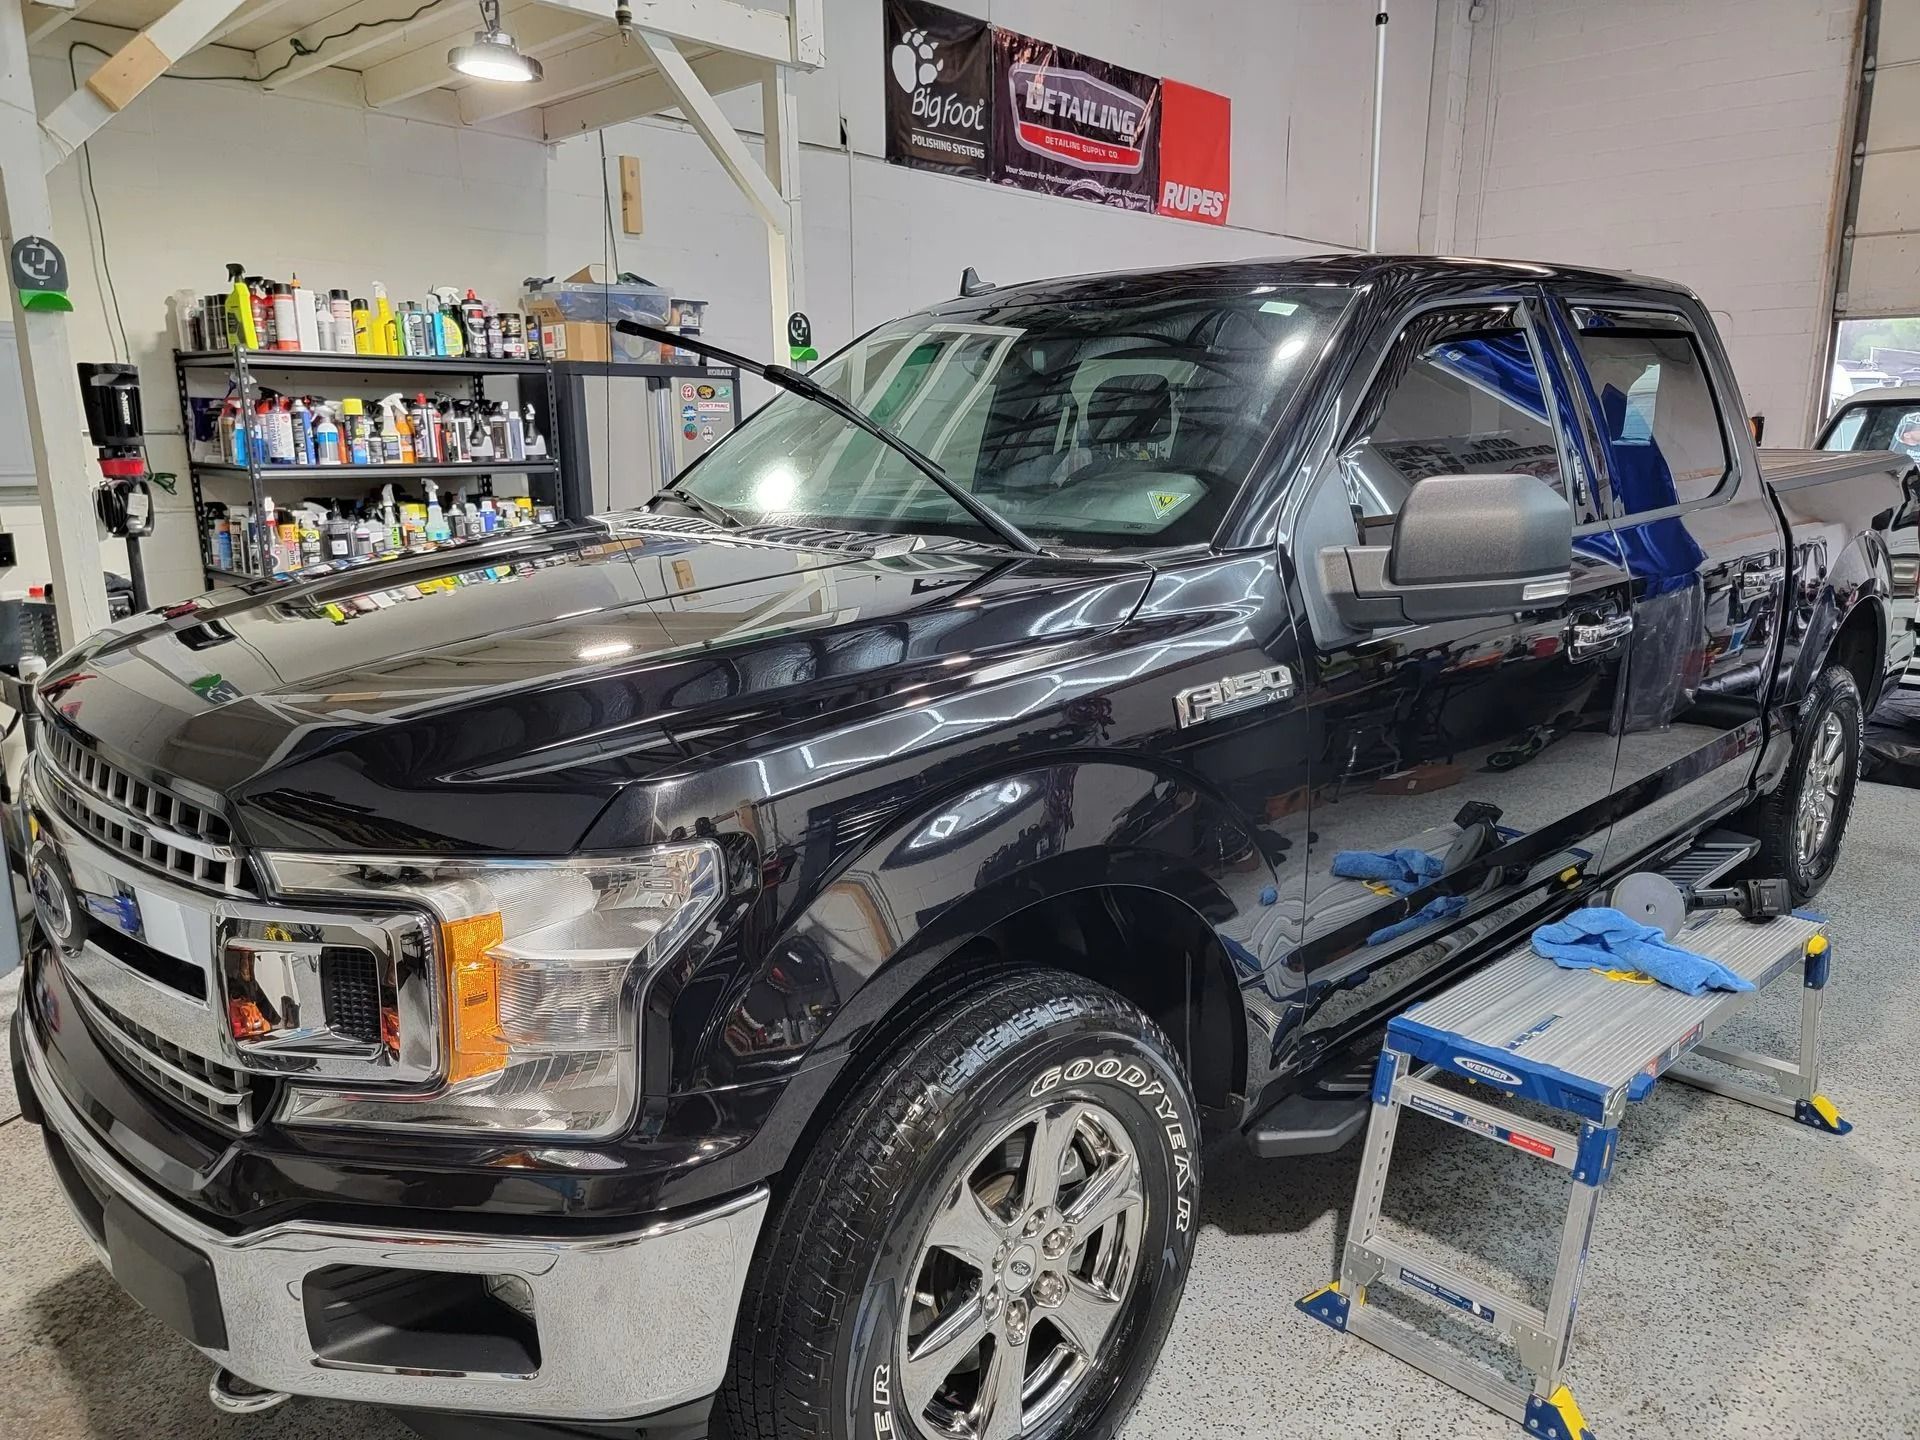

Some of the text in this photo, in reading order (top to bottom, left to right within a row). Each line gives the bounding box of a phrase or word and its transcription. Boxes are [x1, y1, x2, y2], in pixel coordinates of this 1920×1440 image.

[1025, 80, 1136, 135] DETAILING
[911, 134, 985, 160] POLISHING SYSTEMS
[1045, 135, 1081, 151] DETAILING
[1082, 144, 1106, 157] SUPPLY
[1005, 165, 1018, 175] Your
[1018, 168, 1038, 178] Source
[1162, 181, 1223, 218] RUPES
[706, 368, 733, 376] KOBALT
[1267, 688, 1290, 702] XLT
[1465, 1061, 1509, 1081] WERNER
[1030, 1058, 1191, 1233] GOODYEAR
